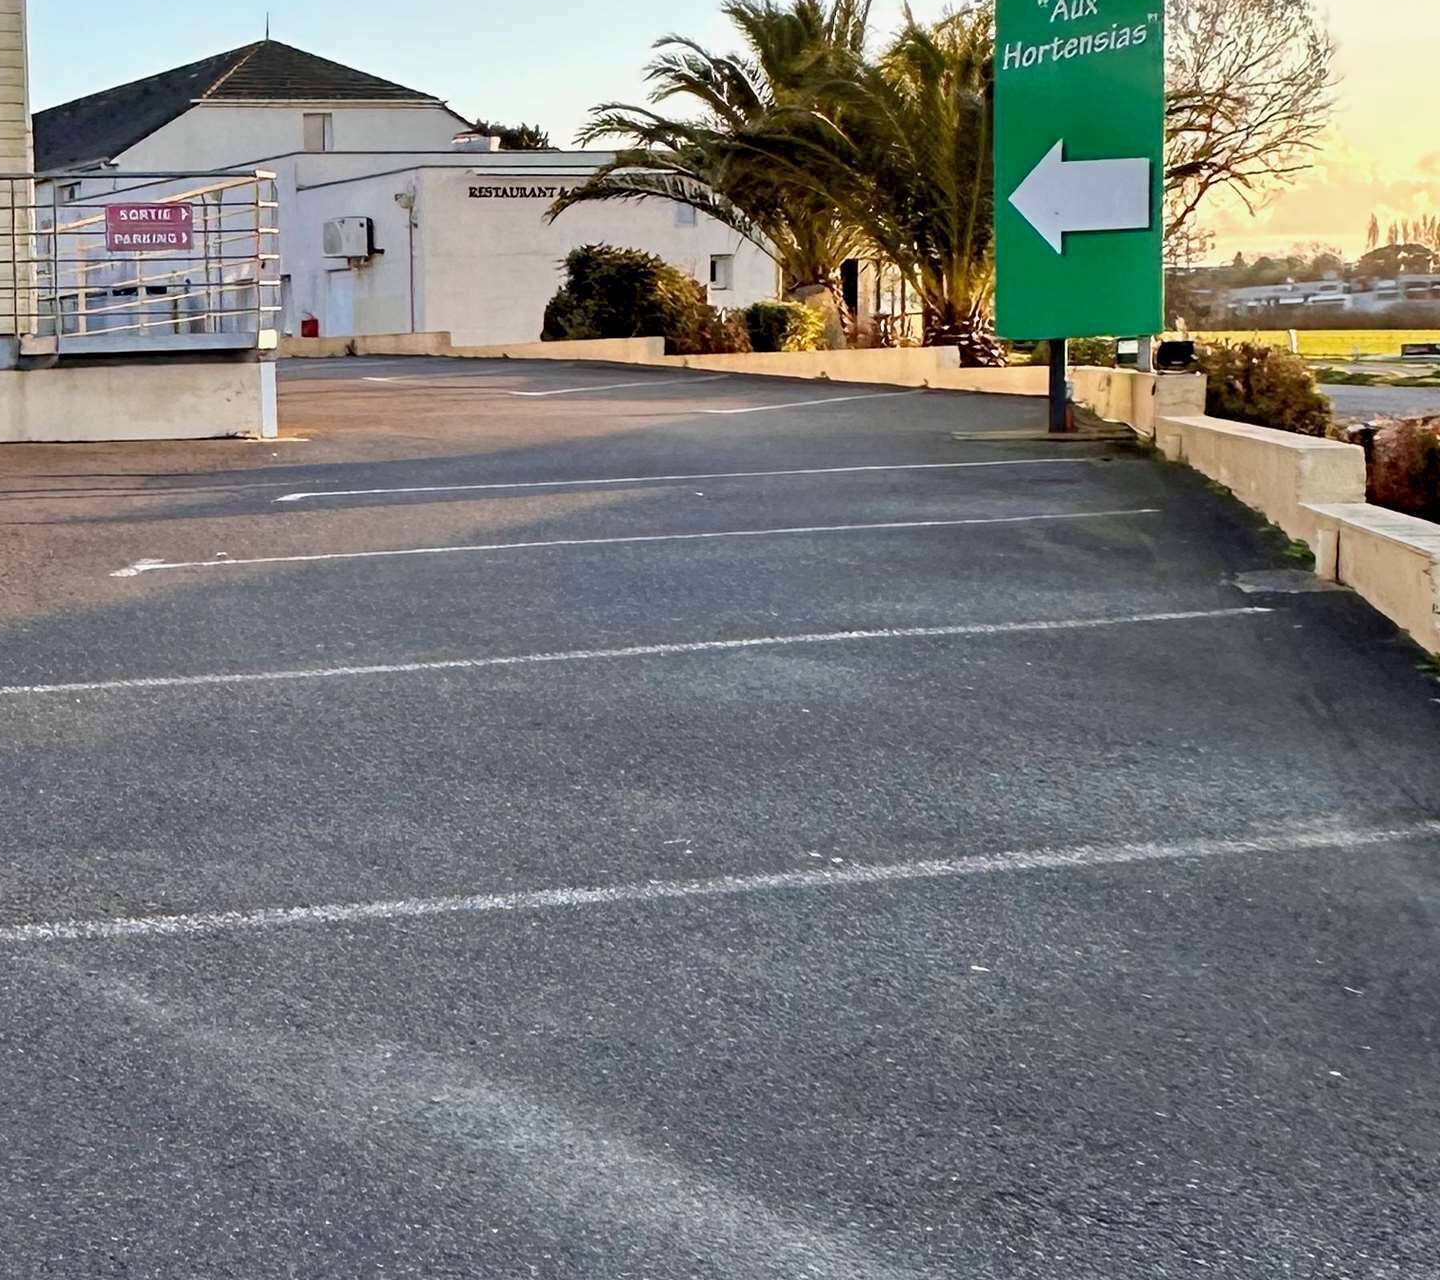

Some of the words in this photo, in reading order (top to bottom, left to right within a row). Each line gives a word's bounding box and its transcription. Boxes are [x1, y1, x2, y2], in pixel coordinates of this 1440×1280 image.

[468, 186, 557, 199] RESTAURANT
[119, 208, 172, 221] SORTIE
[114, 232, 177, 245] PARKING
